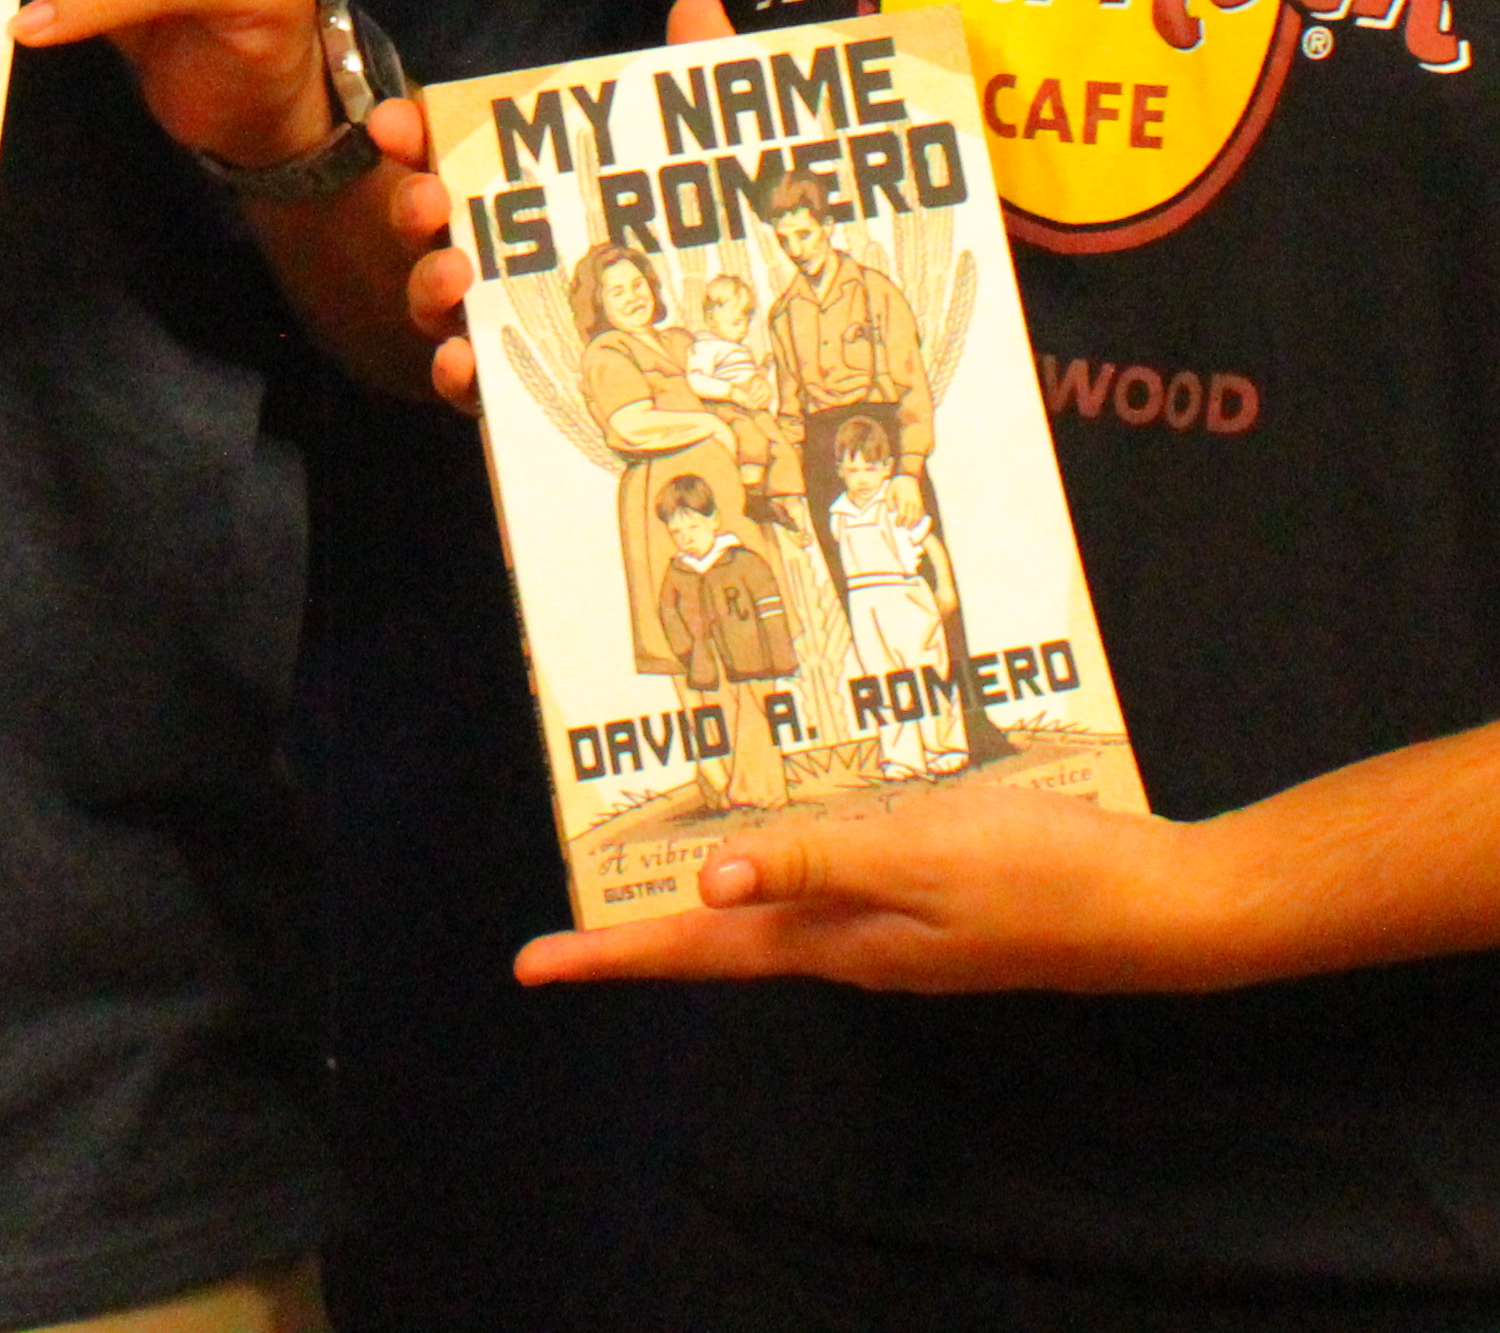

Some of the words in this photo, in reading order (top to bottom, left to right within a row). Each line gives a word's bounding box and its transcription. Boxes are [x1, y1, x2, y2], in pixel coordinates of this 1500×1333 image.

[490, 80, 619, 187] MY
[656, 36, 908, 158] NAME
[984, 73, 1169, 150] CAFE
[468, 185, 560, 281] IS
[602, 120, 970, 256] ROMERO
[568, 705, 733, 782] DAVID
[764, 691, 820, 747] A.
[849, 639, 1080, 731] ROMERO
[604, 877, 676, 904] GUSTAVO
[641, 837, 727, 869] vibra
